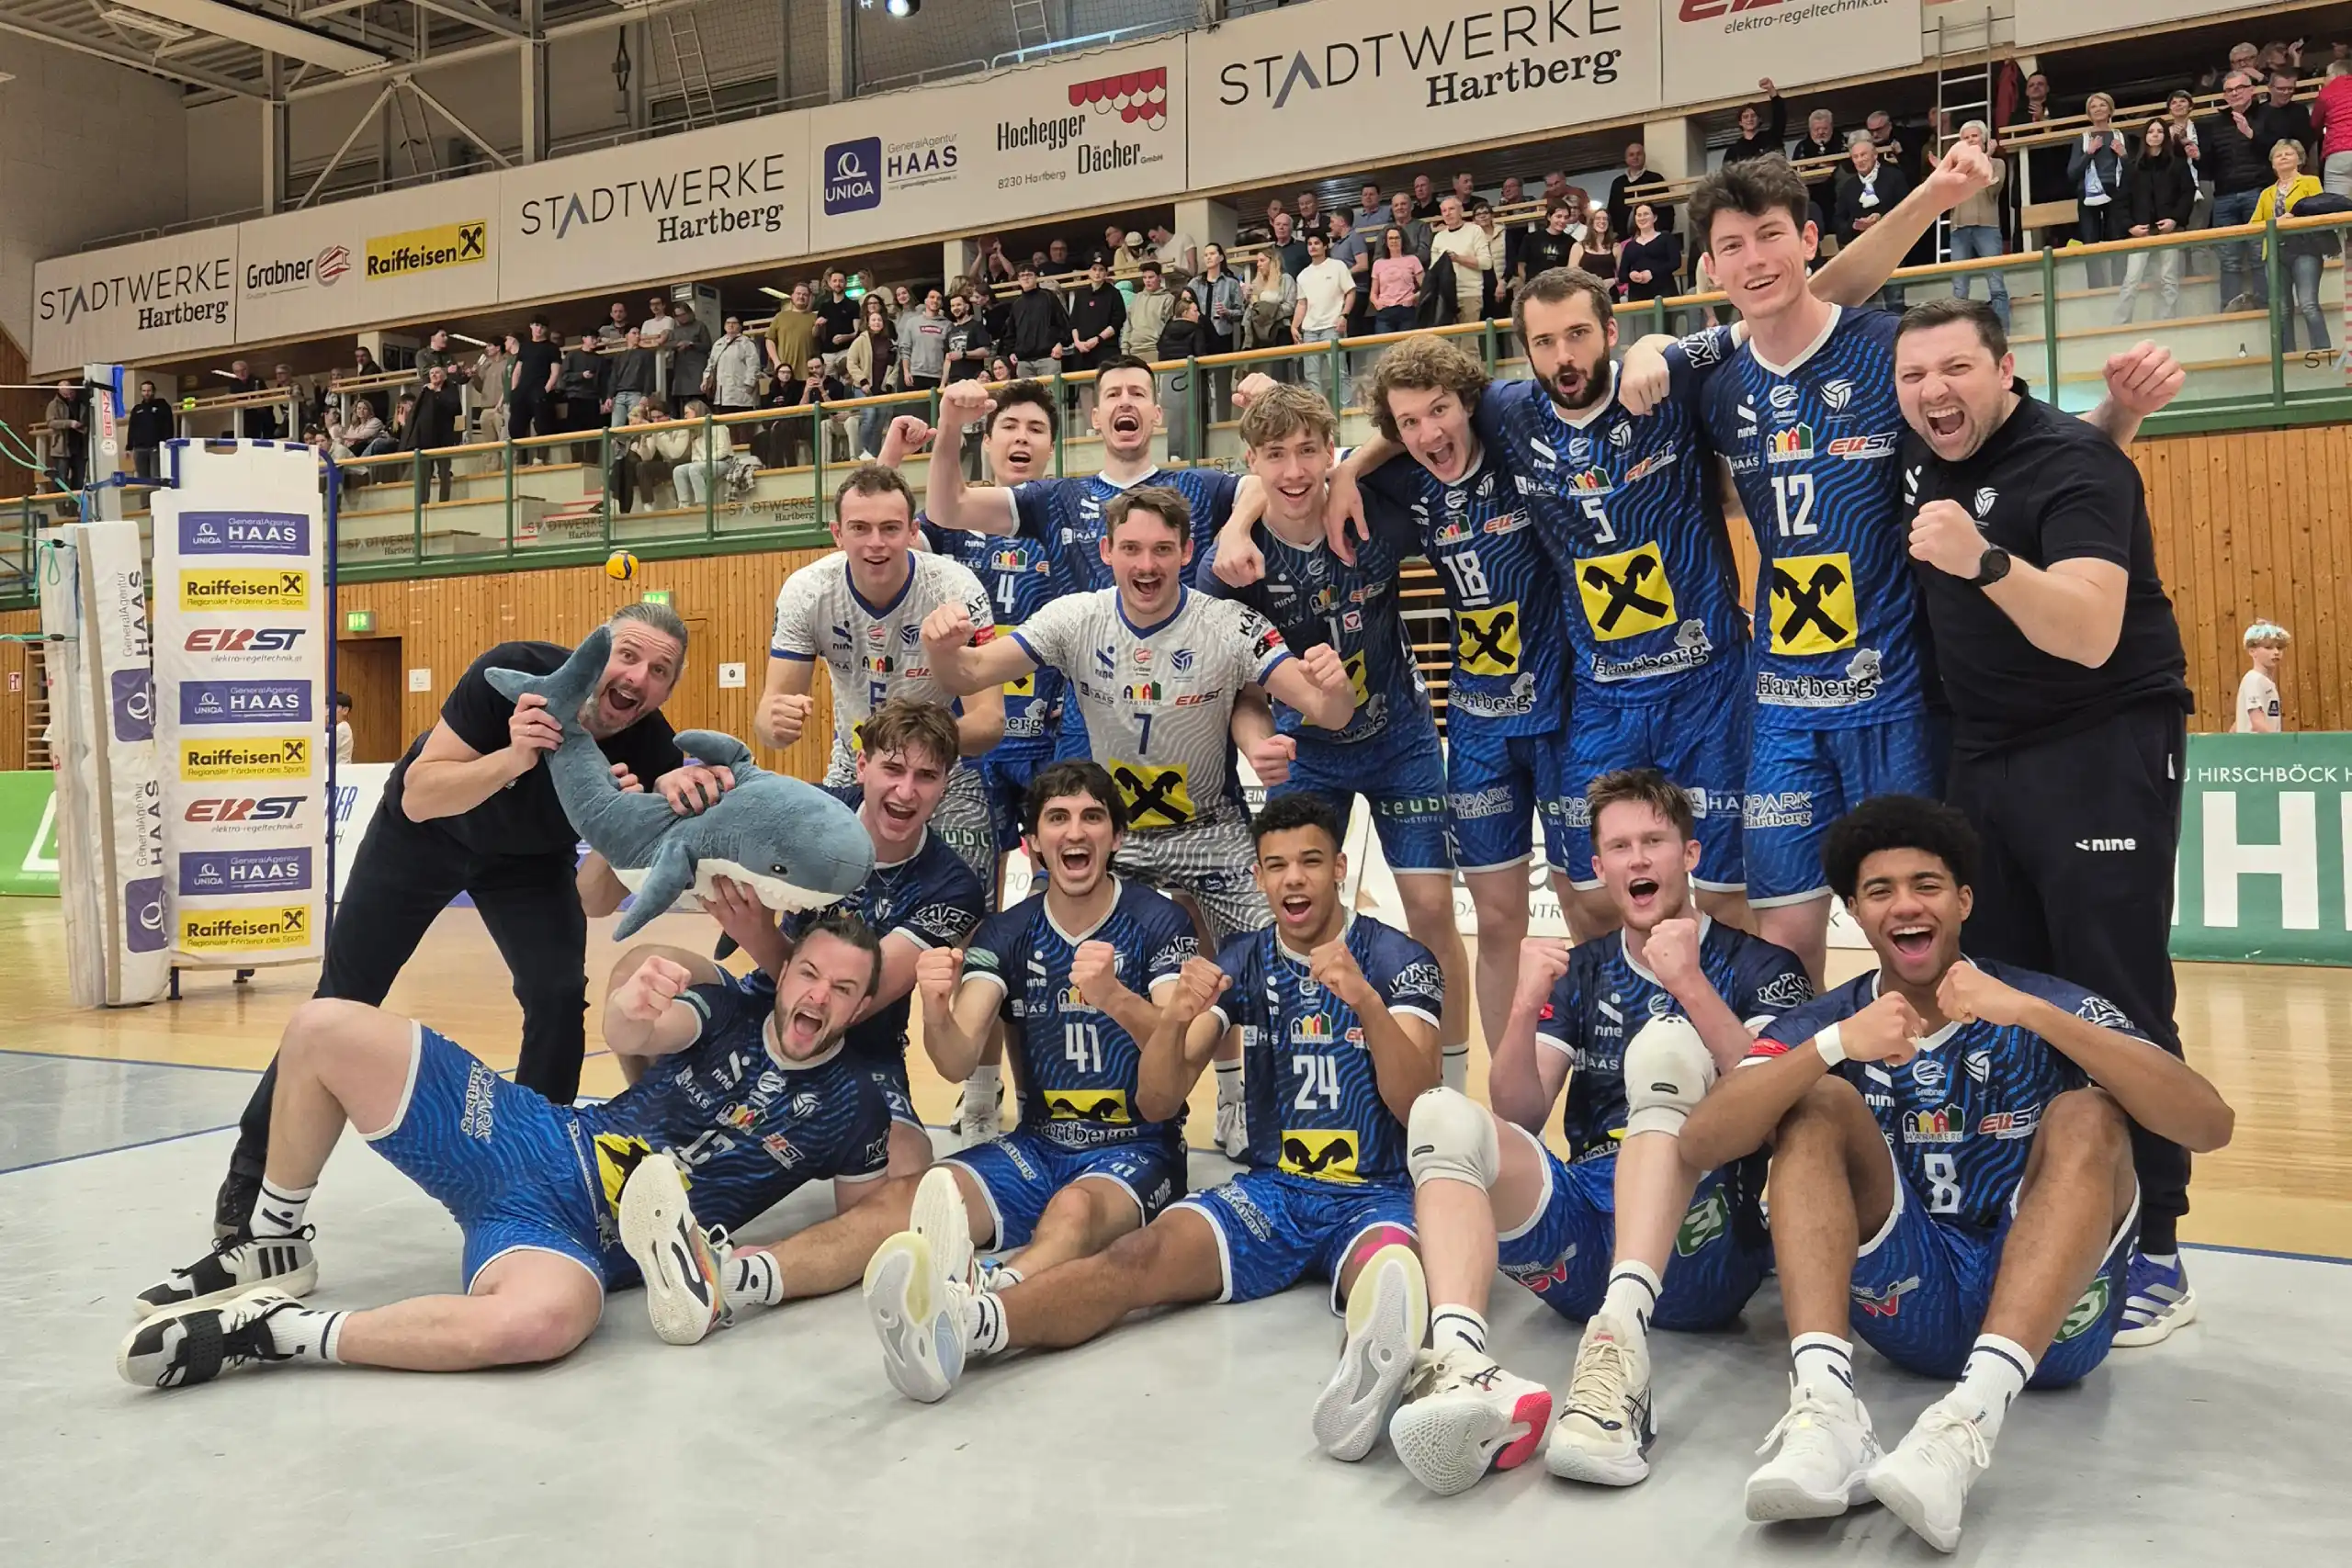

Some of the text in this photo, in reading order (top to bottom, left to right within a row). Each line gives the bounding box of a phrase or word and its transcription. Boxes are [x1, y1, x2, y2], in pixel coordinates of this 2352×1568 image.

[1426, 47, 1623, 109] Hartberg
[888, 133, 957, 153] GeneralAgentur
[998, 114, 1086, 151] Hochegger
[888, 145, 957, 178] HAAS
[1078, 140, 1163, 175] Dächer GmbH
[825, 180, 875, 203] UNIQA
[998, 169, 1067, 189] 8230 Hartberg
[522, 153, 785, 240] STADTWERKE
[657, 203, 783, 243] Hartberg
[247, 258, 313, 289] Grabner
[368, 245, 458, 276] Raiffeisen
[40, 258, 231, 324] STADTWERKE
[138, 300, 228, 331] Hartberg
[1581, 497, 1617, 544] 5
[1770, 474, 1818, 536] 12
[193, 536, 221, 545] UNIQA
[229, 526, 297, 541] HAAS
[187, 580, 279, 596] Raiffeisen
[1441, 550, 1490, 597] 18
[996, 574, 1015, 614] 4
[129, 570, 148, 656] HAAS
[231, 694, 300, 710] HAAS
[1757, 672, 1876, 701] Hartberg
[194, 706, 223, 715] UNIQA
[1134, 713, 1152, 756] 7
[187, 750, 281, 766] Raiffeisen
[2199, 763, 2338, 783] HIRSCHBÖCK
[145, 780, 163, 866] HAAS
[2091, 837, 2138, 852] nine
[193, 877, 224, 886] UNIQA
[230, 863, 300, 880] HAAS
[187, 919, 280, 937] Raiffeisen
[1066, 1022, 1102, 1073] 41
[1293, 1055, 1340, 1110] 24
[1924, 1154, 1962, 1213] 8
